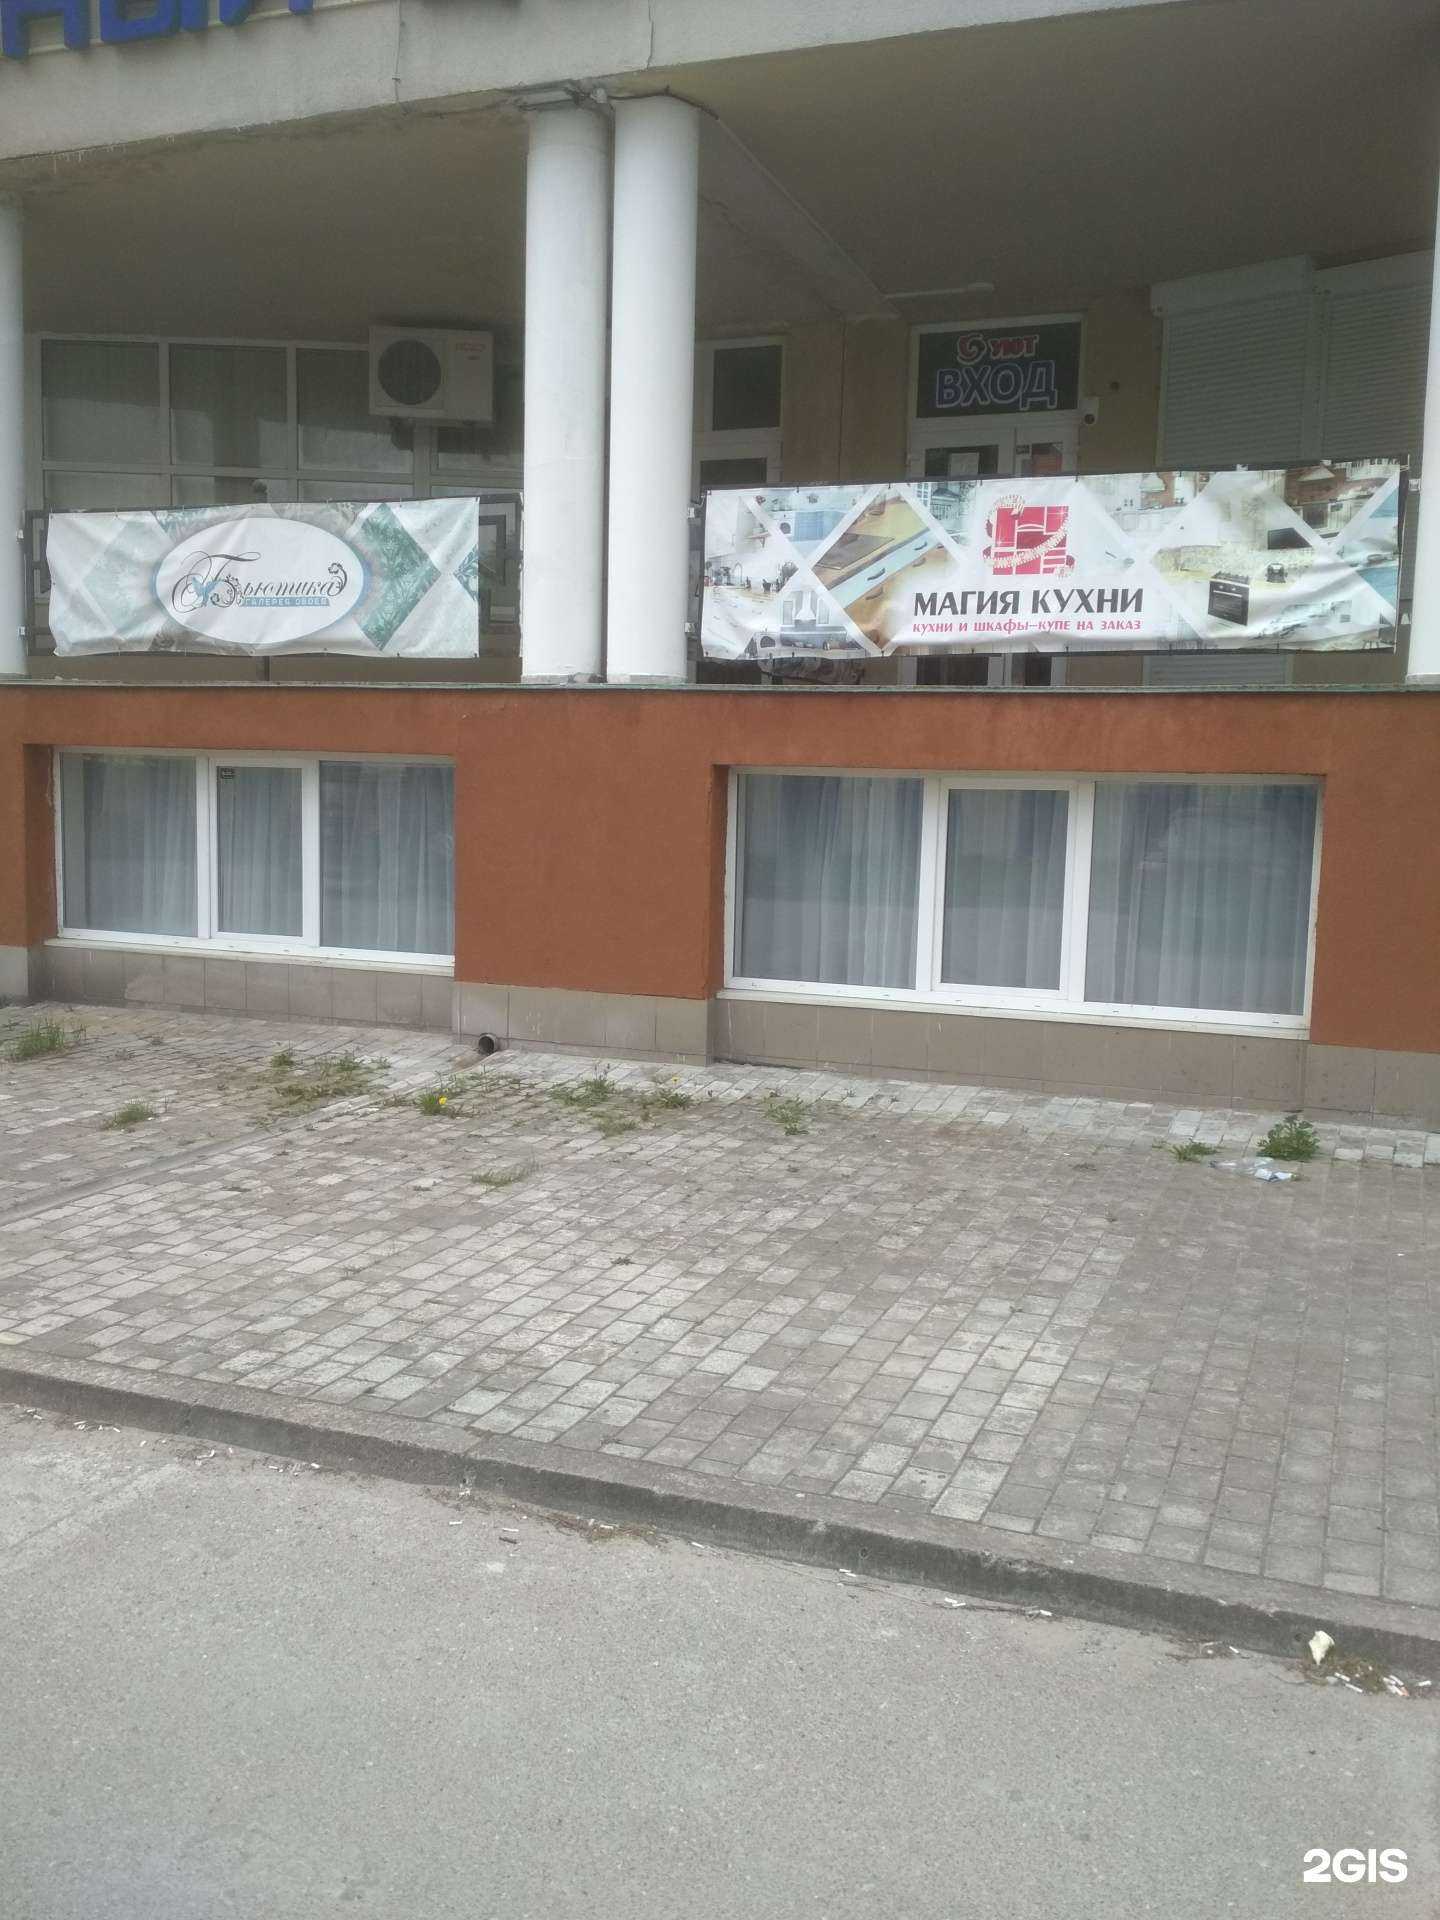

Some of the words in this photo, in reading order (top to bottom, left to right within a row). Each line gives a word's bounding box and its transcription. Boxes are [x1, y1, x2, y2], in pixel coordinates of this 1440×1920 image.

[936, 361, 1057, 411] ВХОД
[914, 590, 1020, 616] МАГИЯ
[1031, 588, 1144, 614] КУХНИ
[913, 621, 953, 635] КУХНИ
[959, 622, 969, 632] И
[1076, 621, 1095, 631] НА
[1101, 619, 1142, 631] ЗАКАЗ
